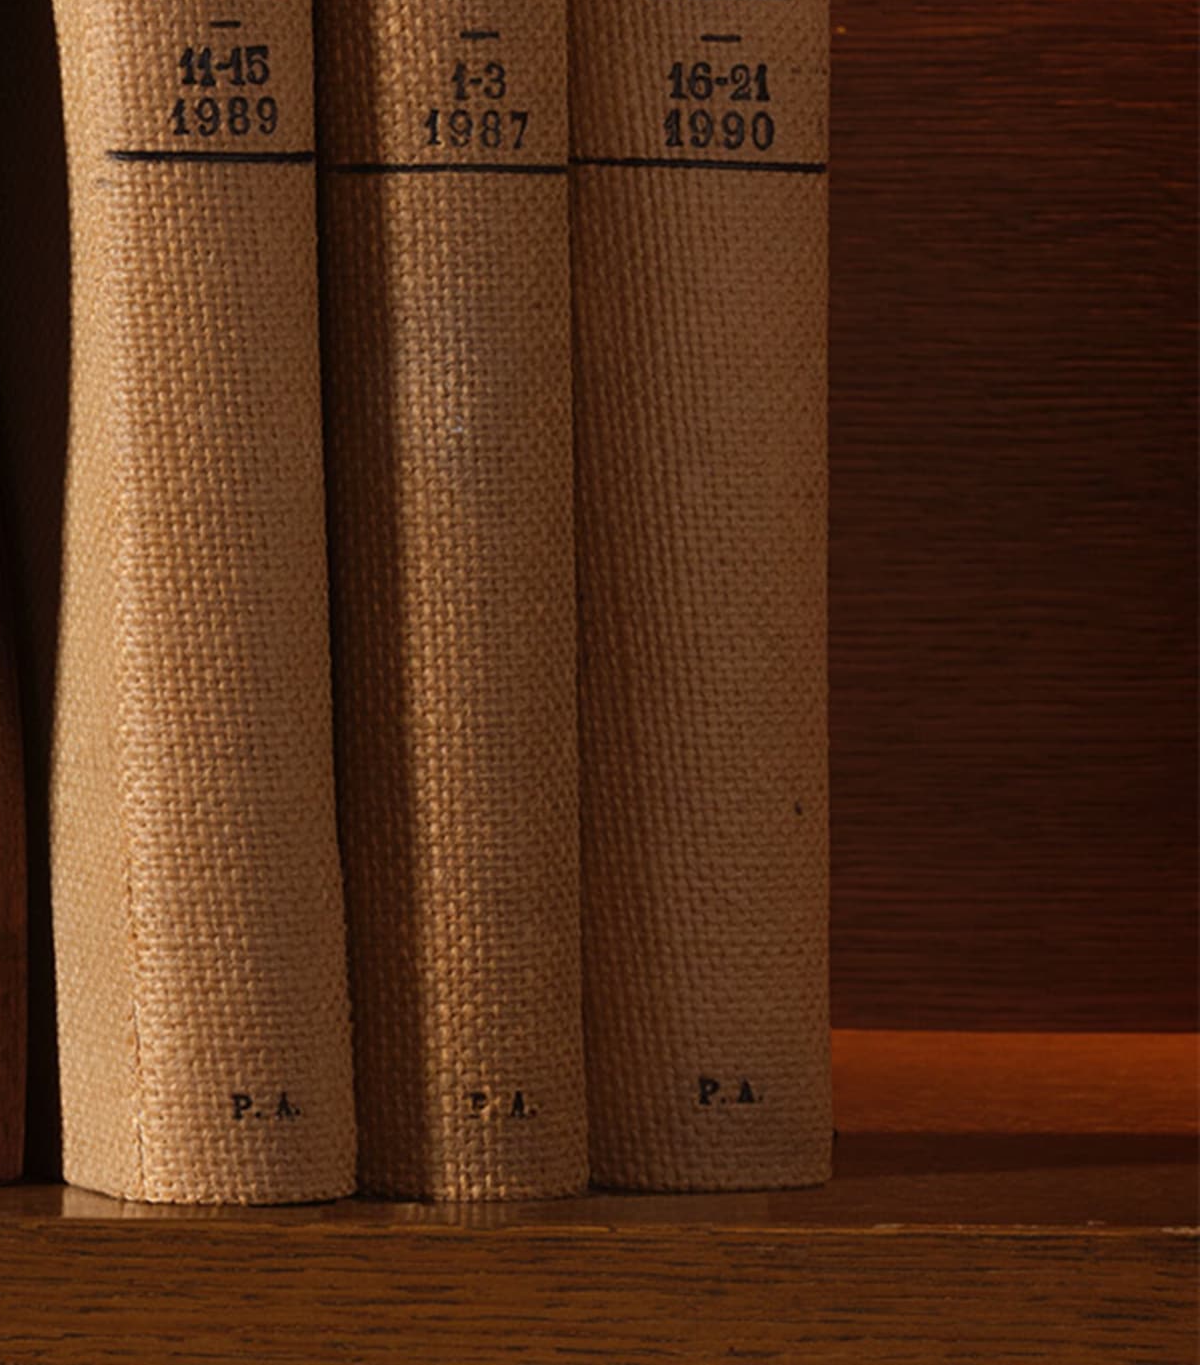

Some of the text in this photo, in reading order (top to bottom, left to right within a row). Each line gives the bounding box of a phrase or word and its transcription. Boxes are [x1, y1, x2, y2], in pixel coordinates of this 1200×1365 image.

[179, 45, 270, 86] 11-15
[451, 61, 507, 100] 1-3
[667, 61, 770, 101] 16-21
[170, 95, 279, 137] 1989
[424, 108, 529, 150] 1987
[663, 108, 775, 151] 1990
